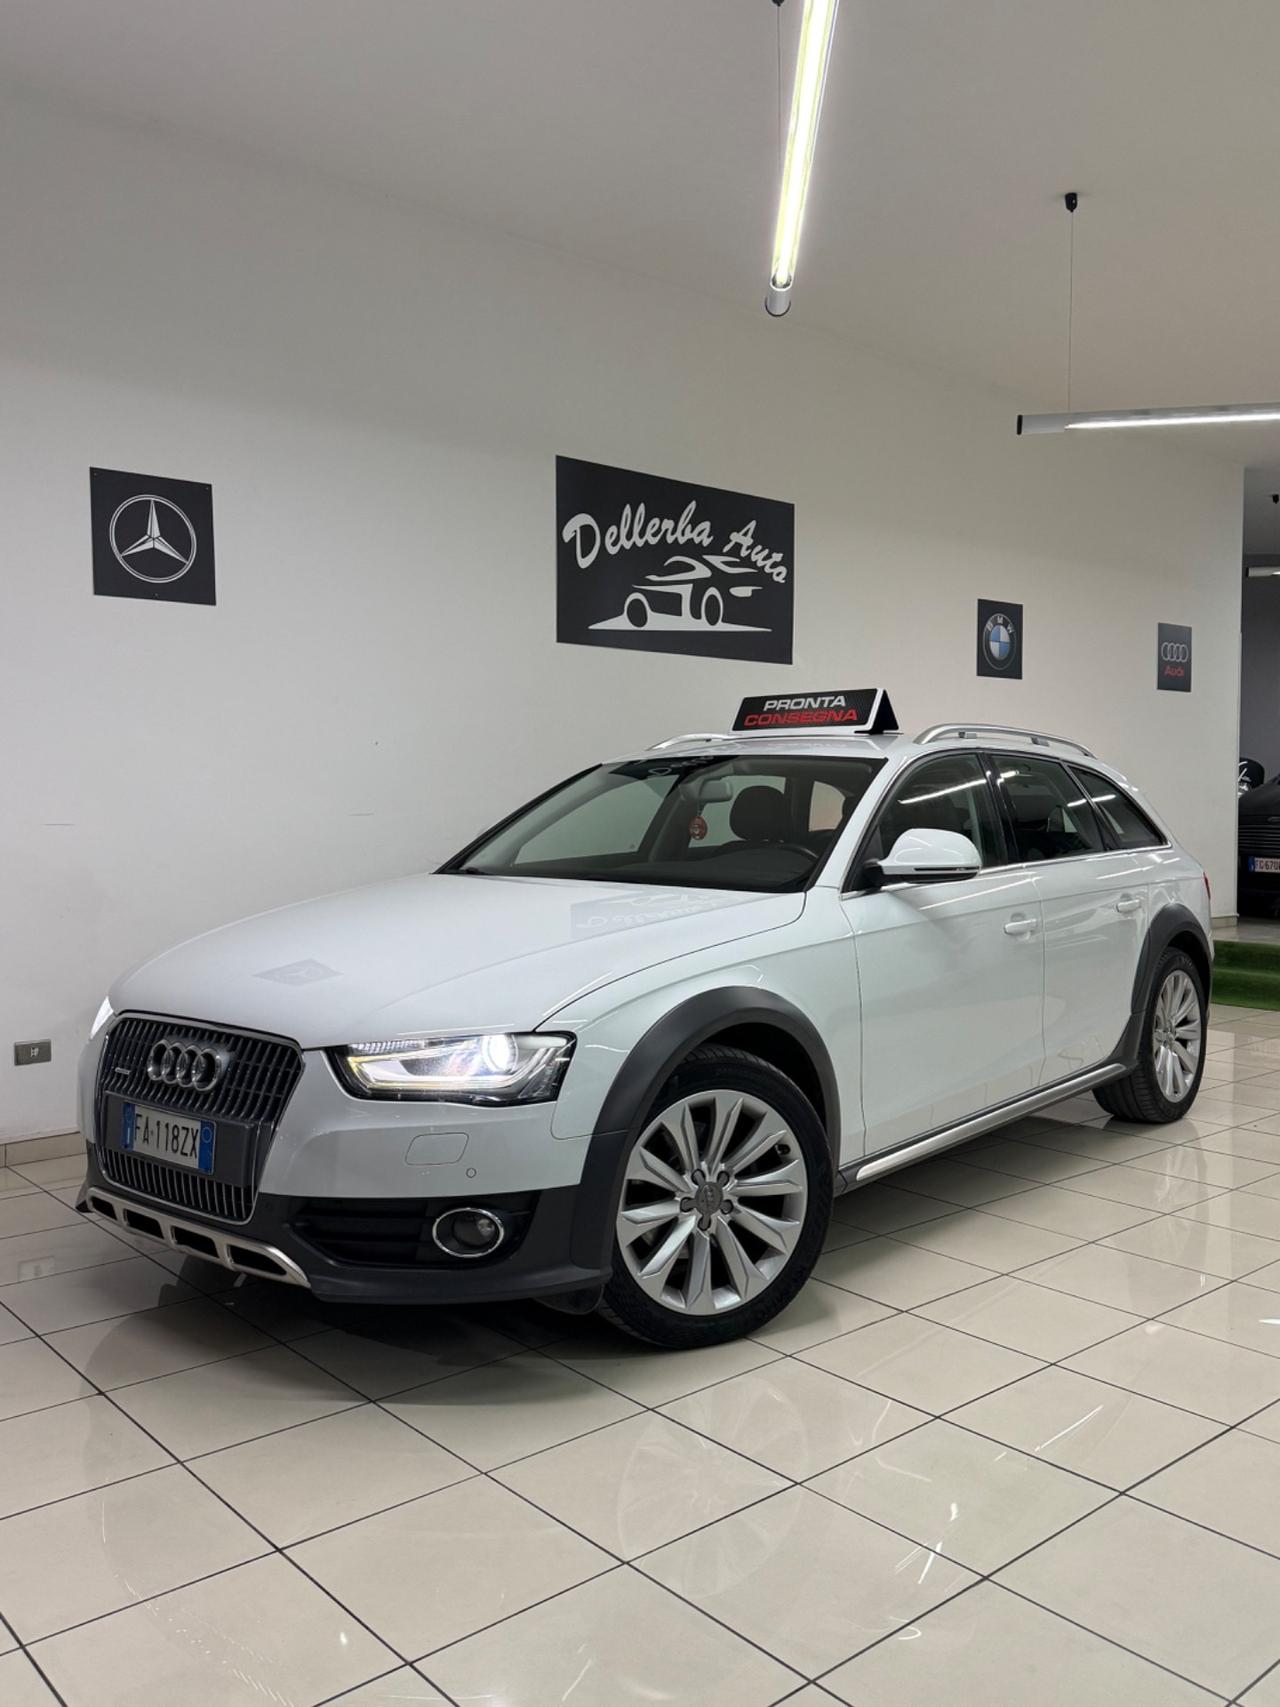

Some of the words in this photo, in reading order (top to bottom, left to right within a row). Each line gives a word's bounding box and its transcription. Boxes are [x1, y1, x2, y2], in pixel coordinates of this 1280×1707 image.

[562, 500, 714, 569] Dellerba
[722, 519, 788, 584] Auto
[985, 615, 1015, 634] BMW
[1164, 665, 1185, 677] Audi
[763, 695, 846, 711] PRONTA
[744, 709, 858, 727] CONSEGNA
